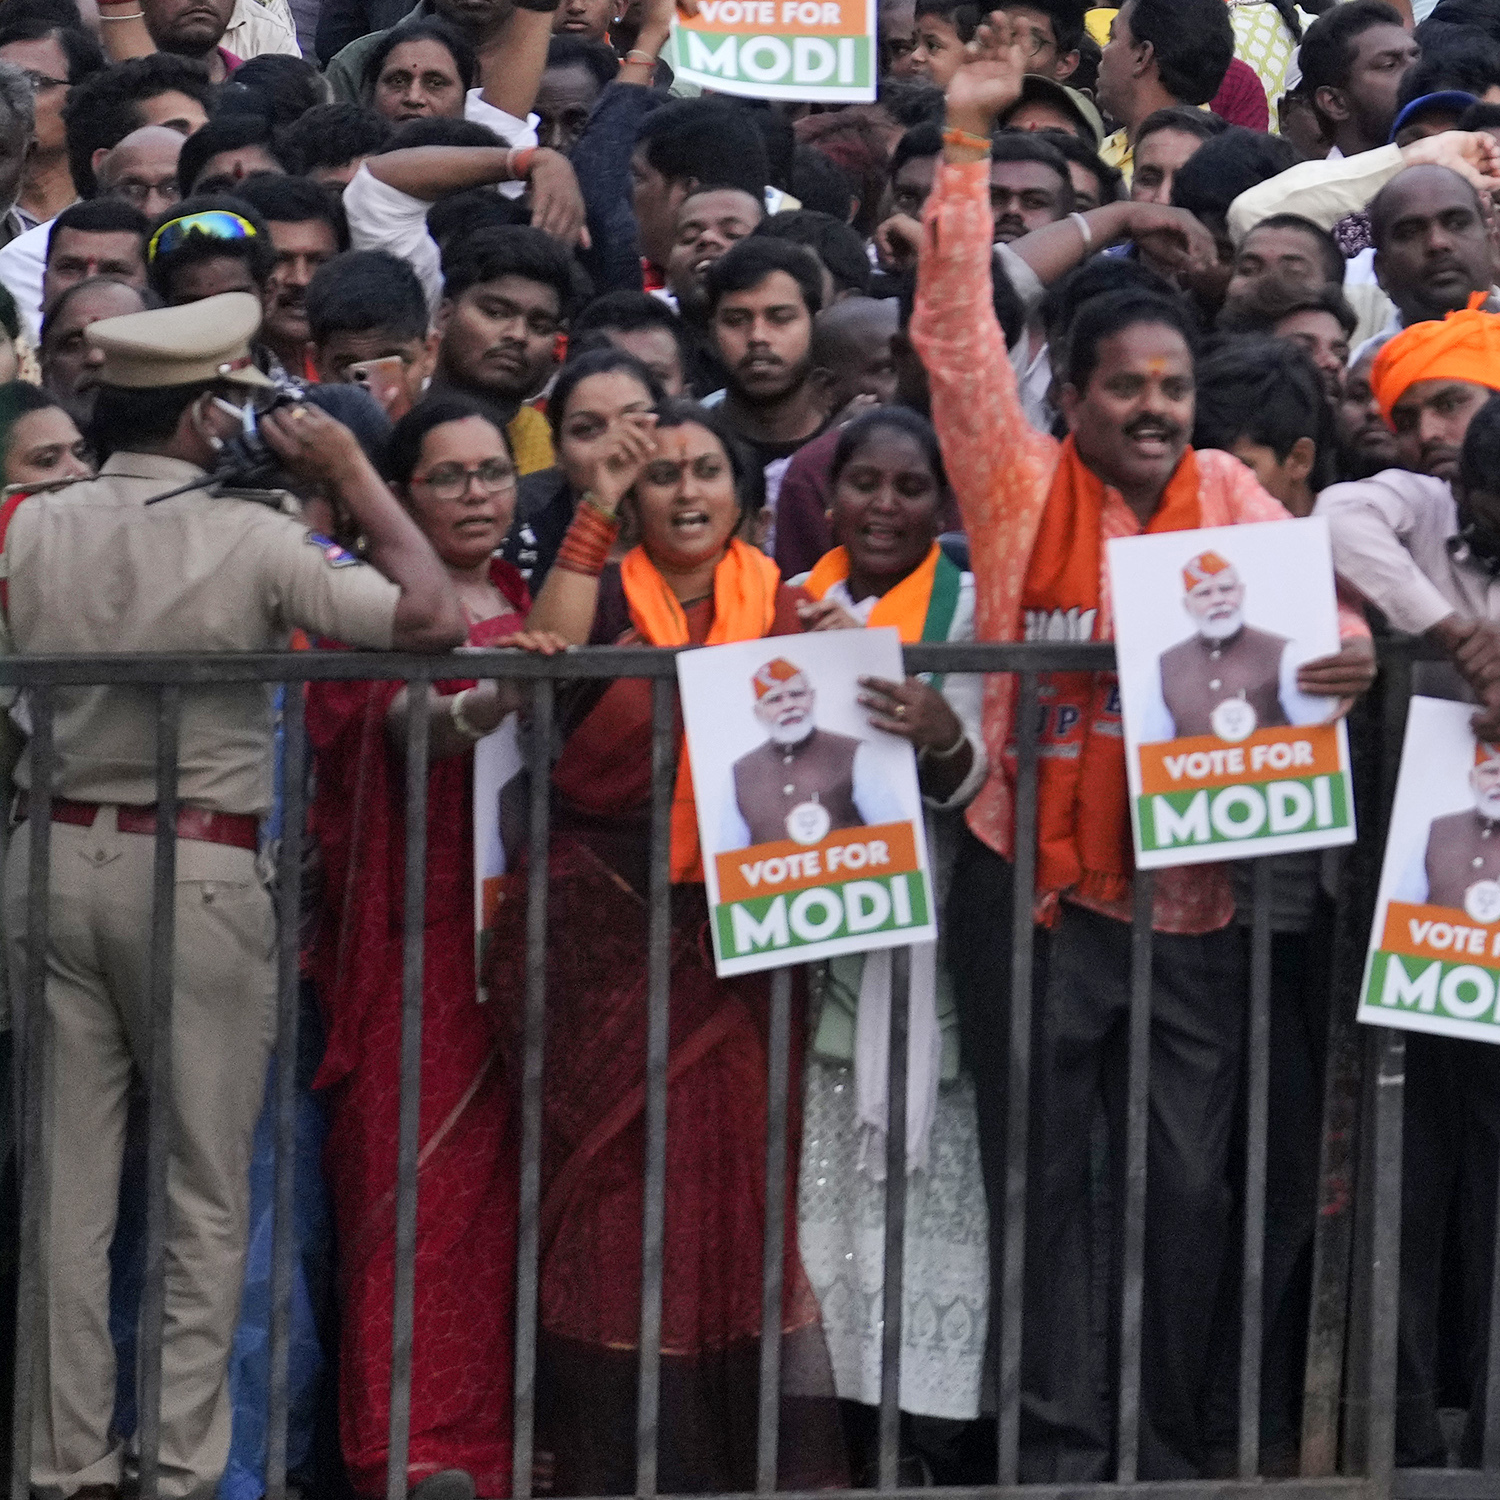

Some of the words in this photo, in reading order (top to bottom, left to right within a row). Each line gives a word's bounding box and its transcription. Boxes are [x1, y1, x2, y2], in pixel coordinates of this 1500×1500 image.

[699, 0, 774, 25] VOTE
[781, 1, 841, 25] FOR
[687, 31, 856, 84] MODI
[1163, 748, 1245, 780] VOTE
[1251, 740, 1314, 772] FOR
[1152, 775, 1334, 848] MODI
[739, 850, 822, 887] VOTE
[826, 840, 890, 872] FOR
[730, 874, 912, 952] MODI
[1408, 918, 1487, 955] VOTE
